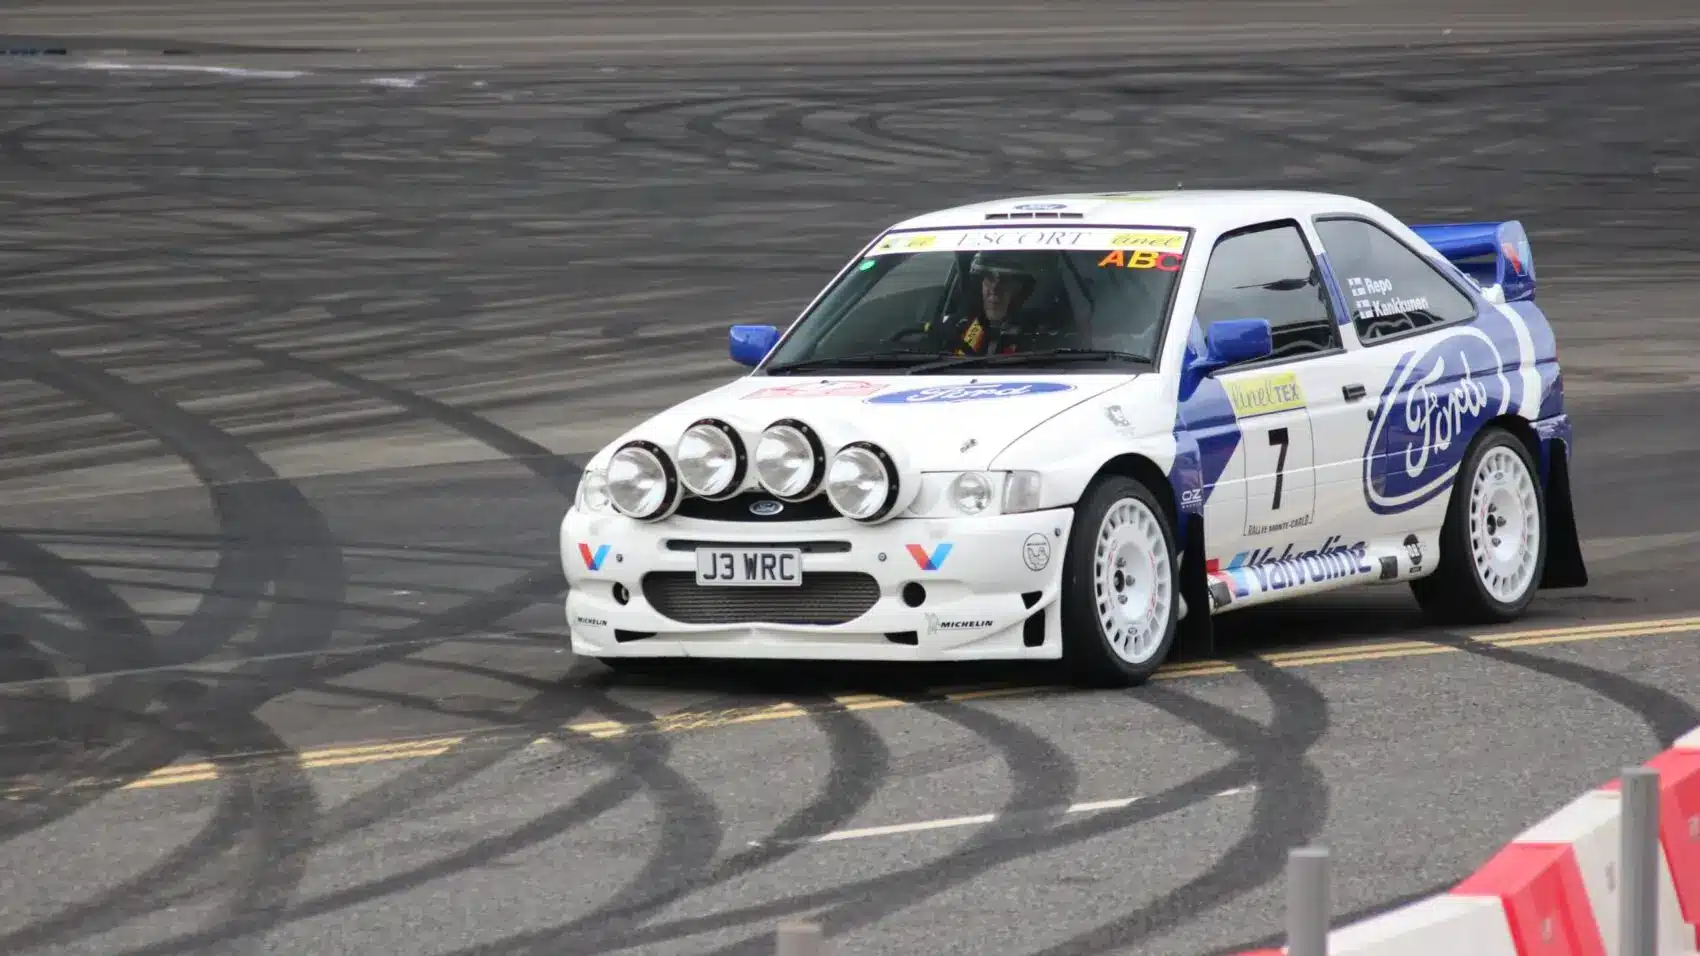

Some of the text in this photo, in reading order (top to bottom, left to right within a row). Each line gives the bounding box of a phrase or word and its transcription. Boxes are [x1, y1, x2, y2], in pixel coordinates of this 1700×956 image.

[957, 231, 1091, 248] ESCORT
[1098, 250, 1184, 272] ABC
[1364, 278, 1393, 296] Repo
[1373, 296, 1430, 318] Kankkunen
[905, 384, 1032, 402] Ford
[1405, 349, 1488, 478] Ford
[1267, 427, 1290, 511] 7
[1181, 489, 1202, 501] OZ
[703, 553, 795, 580] J3 WRC
[1249, 534, 1372, 593] Valvoline
[577, 616, 608, 627] MICHELIN
[940, 620, 993, 629] MICHELIN
